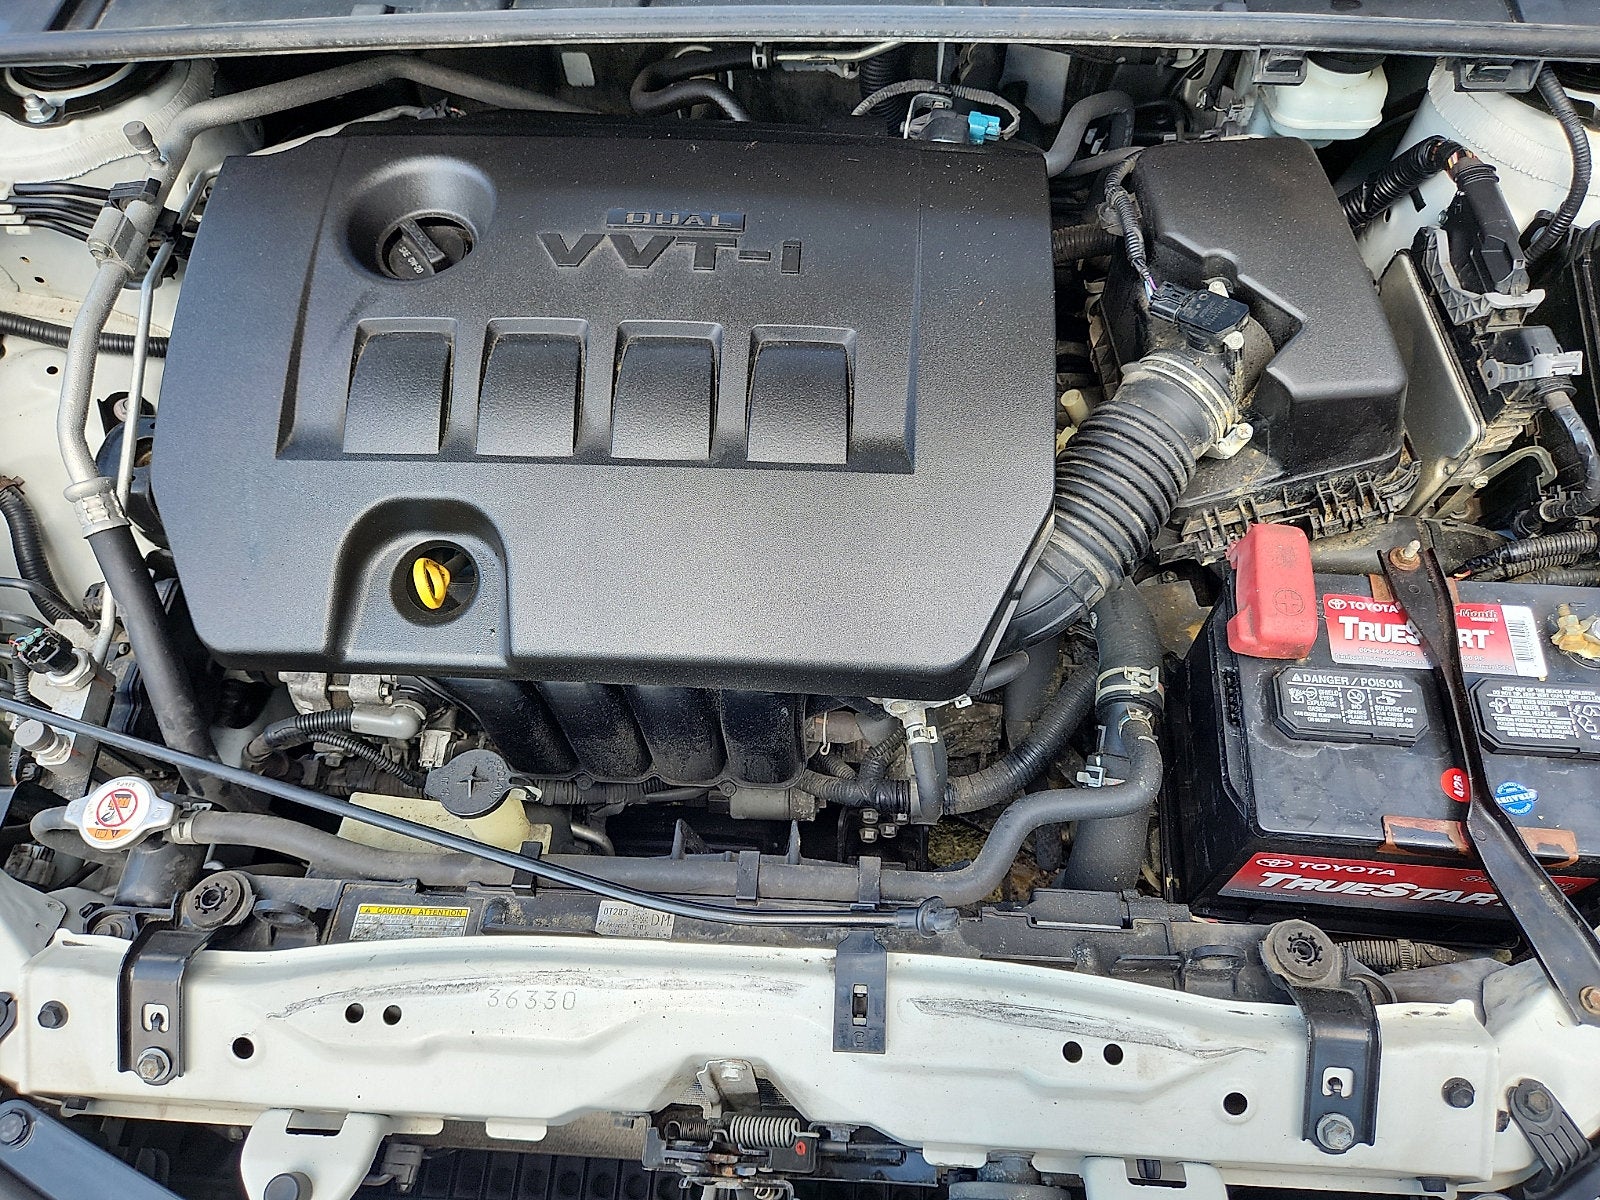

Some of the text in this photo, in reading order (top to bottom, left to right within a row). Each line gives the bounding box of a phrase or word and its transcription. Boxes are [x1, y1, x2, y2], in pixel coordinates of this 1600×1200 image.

[626, 212, 732, 227] DUAL
[1347, 600, 1399, 613] TOYOTA
[1302, 674, 1350, 686] DANGER
[1360, 677, 1403, 689] POISON
[1298, 861, 1396, 877] TOYOTA
[1258, 871, 1504, 907] TRUESTAR
[376, 906, 463, 917] CAUTION ATTENTION
[487, 988, 576, 1010] 36330
